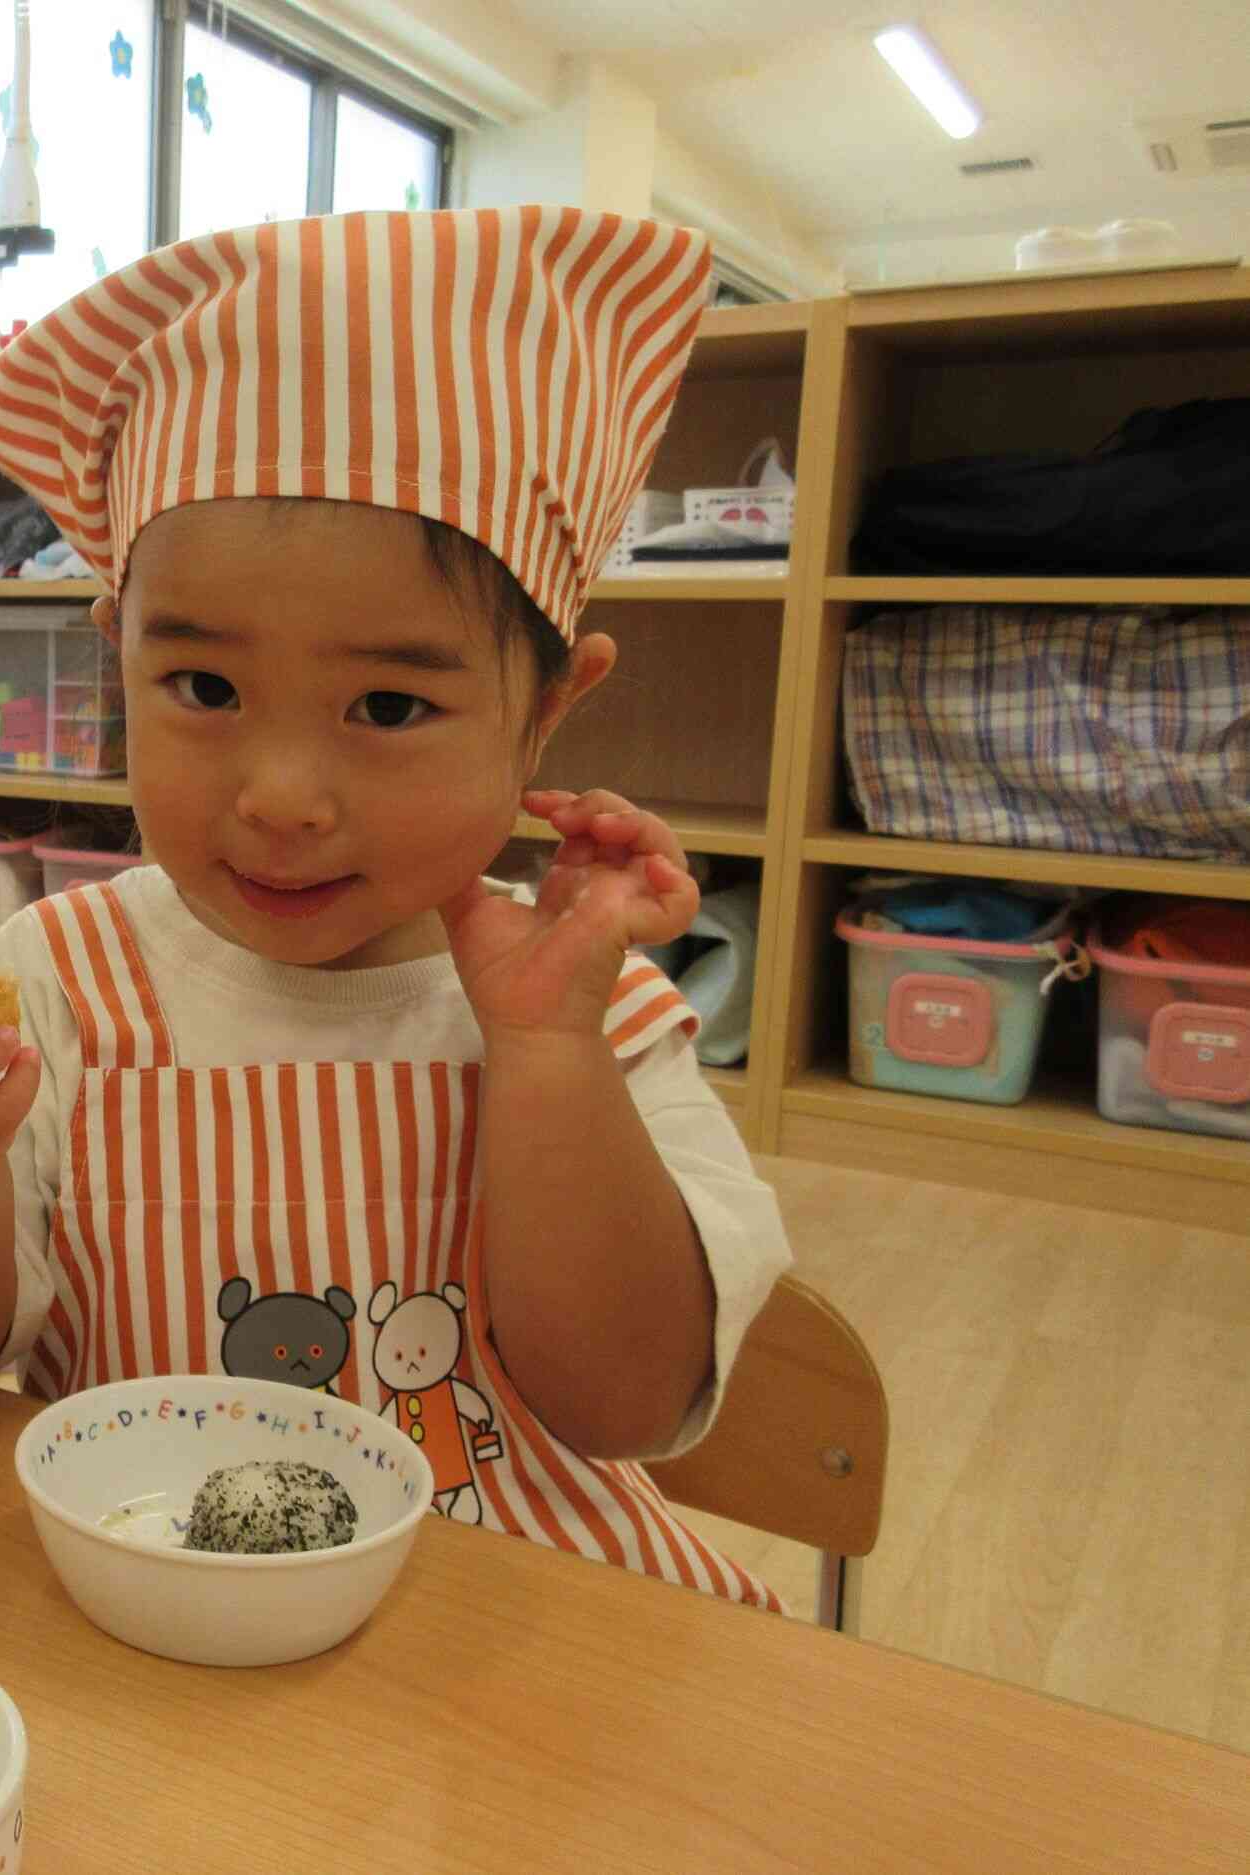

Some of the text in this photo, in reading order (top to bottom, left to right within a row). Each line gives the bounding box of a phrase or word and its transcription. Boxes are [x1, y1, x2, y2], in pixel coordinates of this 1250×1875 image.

[116, 1409, 133, 1427] D
[158, 1399, 174, 1420] E
[194, 1409, 207, 1430] F
[230, 1400, 247, 1421] G
[313, 1409, 326, 1430] I
[375, 1447, 388, 1471] K
